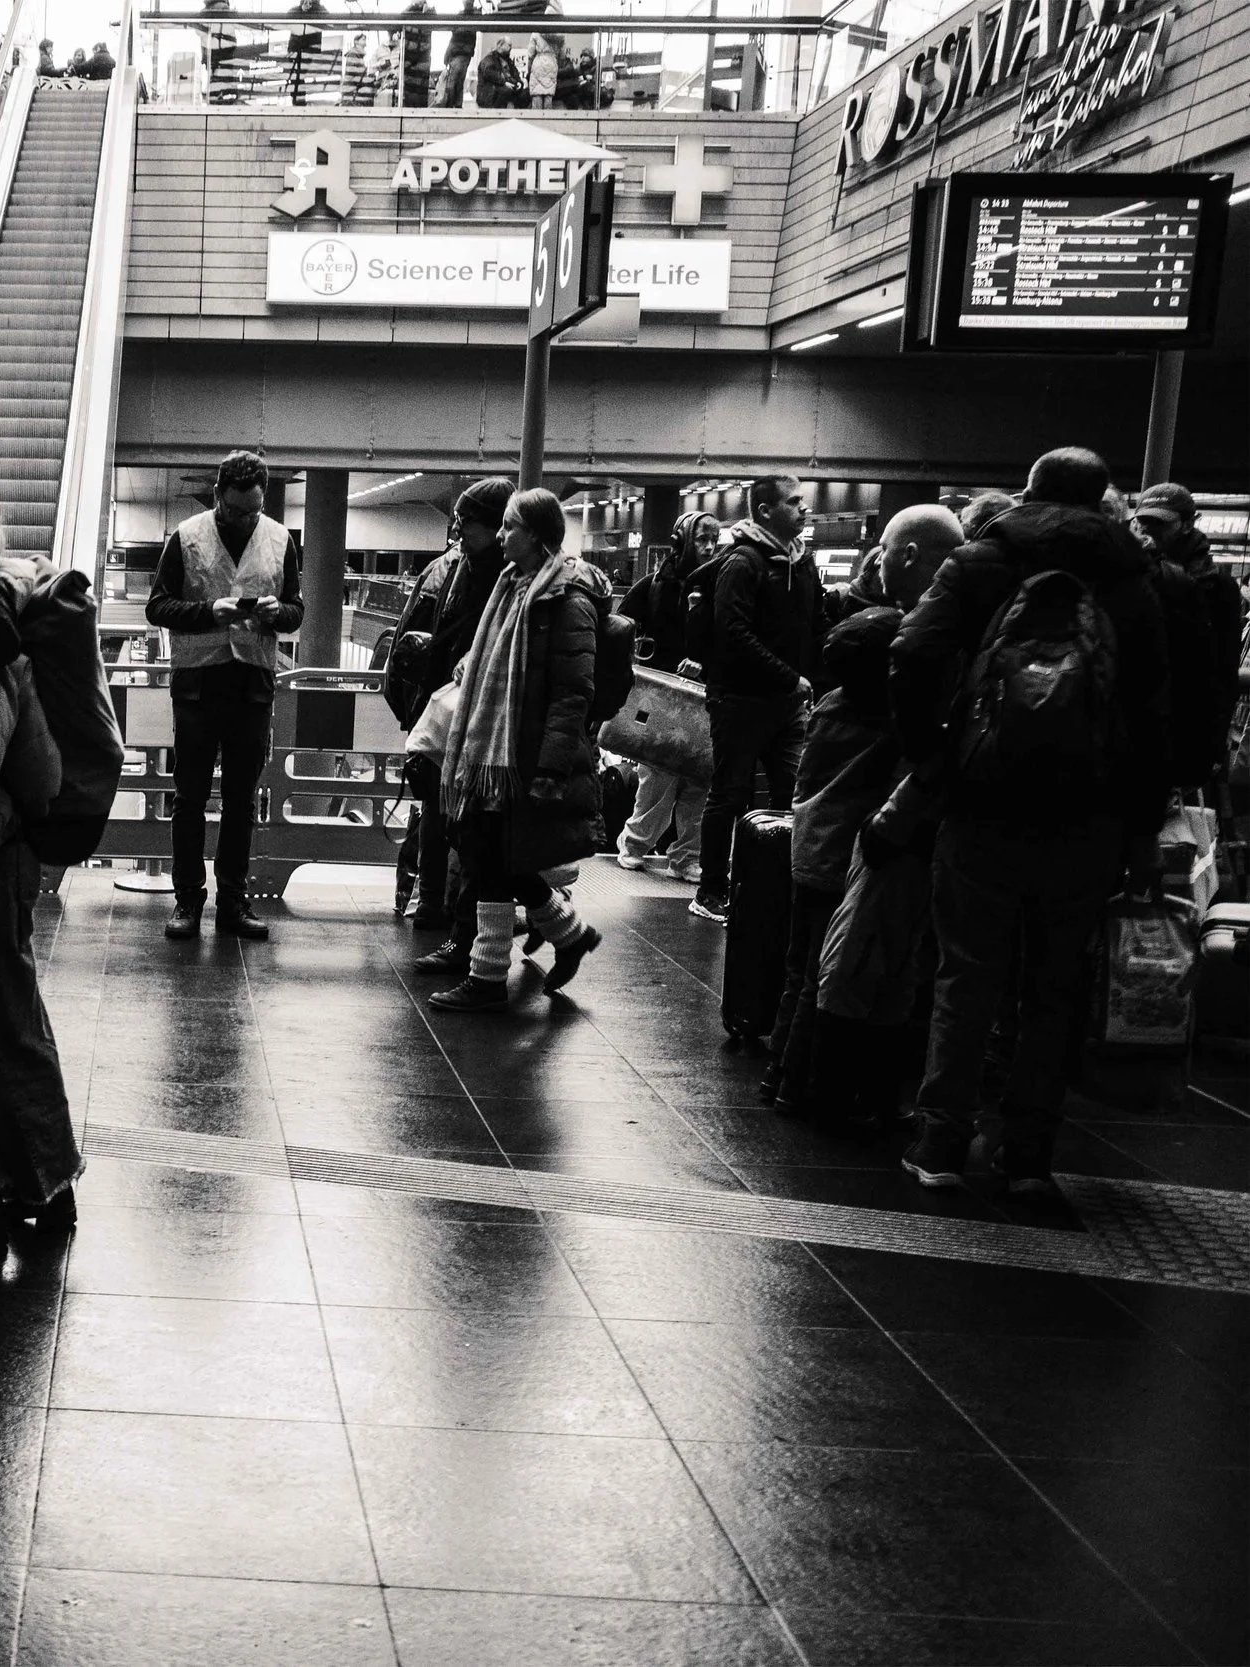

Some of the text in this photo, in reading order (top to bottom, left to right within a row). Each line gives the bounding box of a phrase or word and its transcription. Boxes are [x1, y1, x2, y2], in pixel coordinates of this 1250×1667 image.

[835, 0, 1125, 175] ROSSMA
[1051, 12, 1165, 151] Bahnhof
[1020, 226, 1045, 235] Rostock
[535, 193, 576, 308] 5 6
[306, 263, 354, 273] BAYER
[324, 244, 336, 293] BAYER
[368, 258, 474, 281] Science
[482, 261, 526, 282] For
[652, 264, 701, 286] Life
[1015, 278, 1039, 287] Rostock
[1012, 297, 1063, 307] Hamburg-Altona
